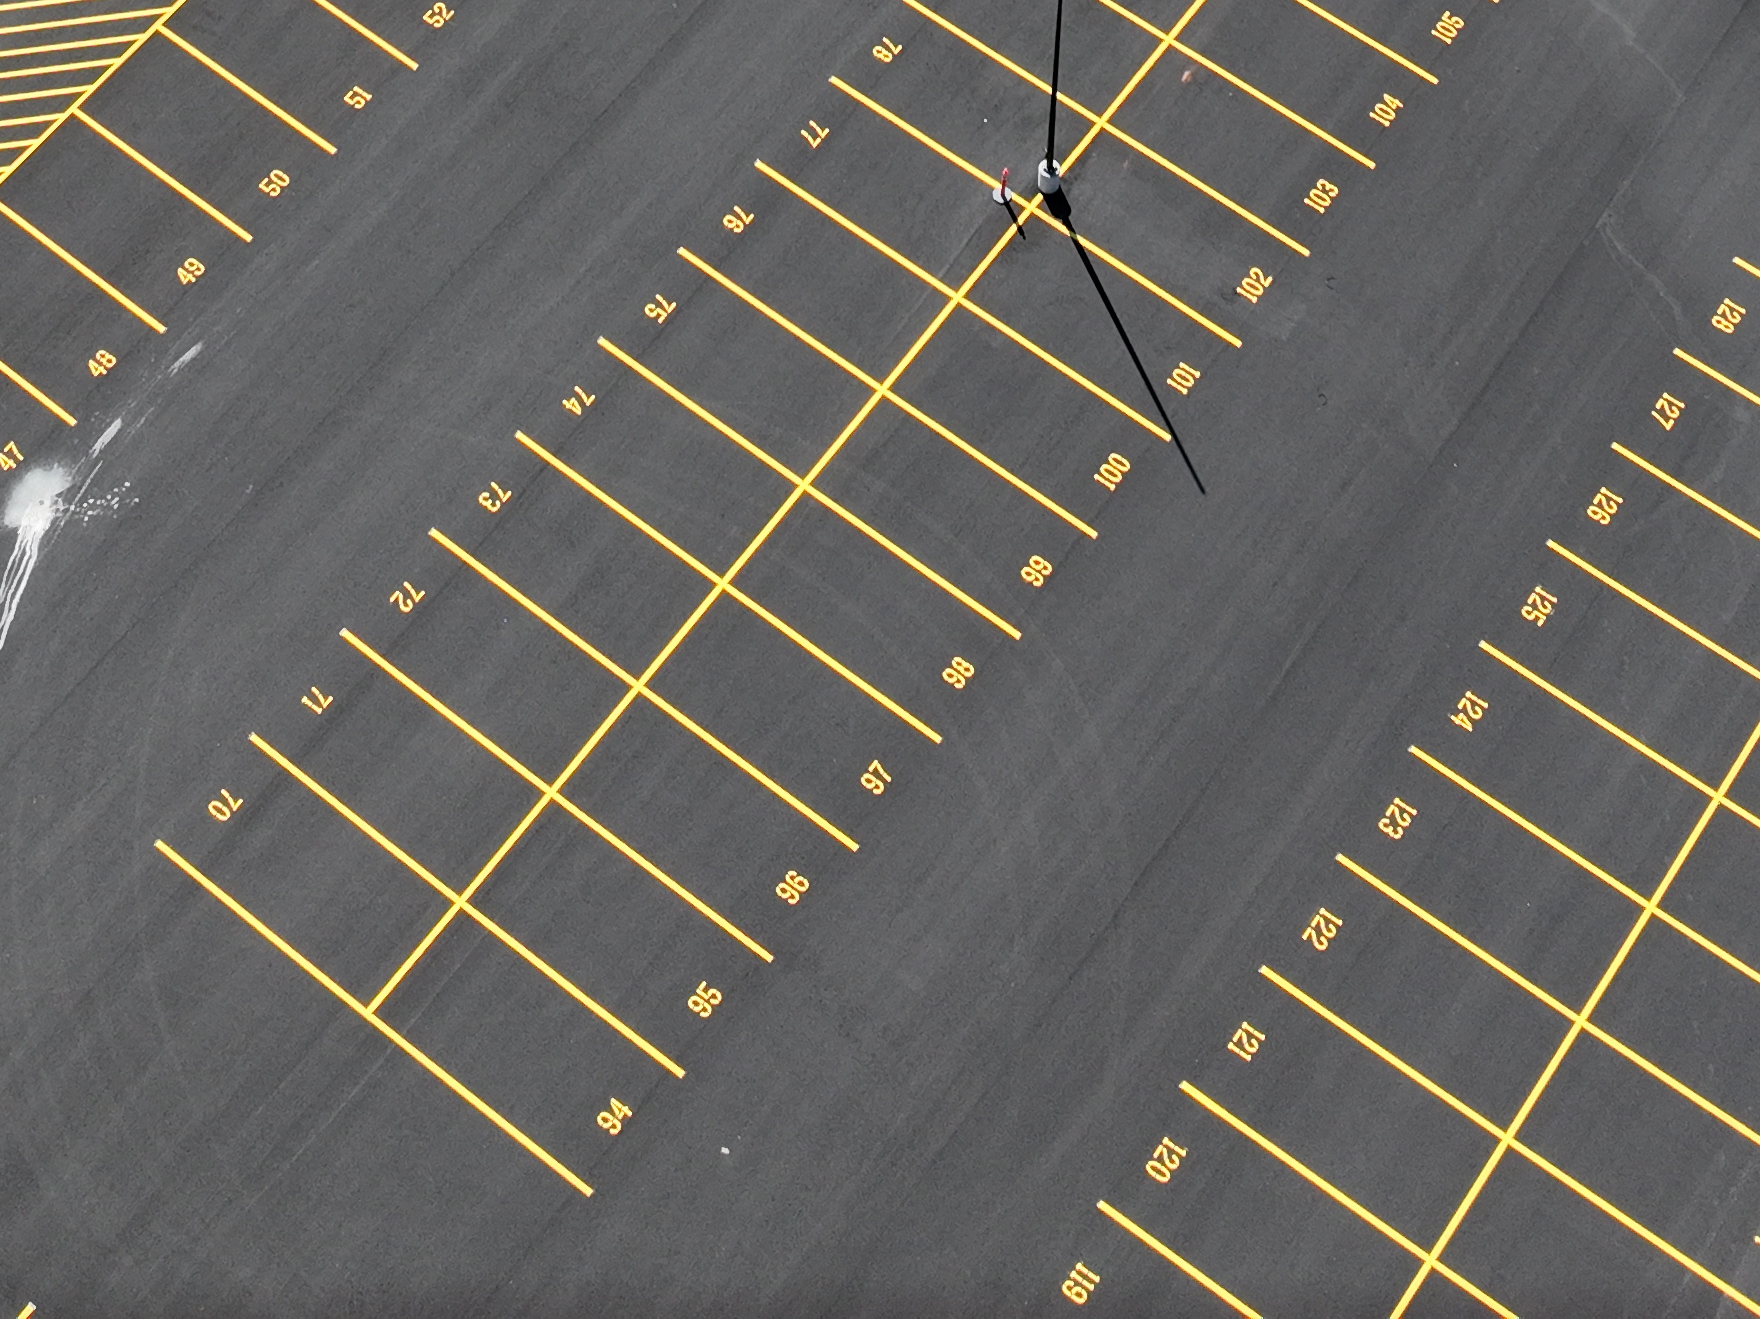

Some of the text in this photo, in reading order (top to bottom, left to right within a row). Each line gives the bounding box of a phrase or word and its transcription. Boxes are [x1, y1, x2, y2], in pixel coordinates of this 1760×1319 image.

[423, 2, 454, 28] 52
[872, 37, 902, 63] 78
[1369, 94, 1403, 127] 104
[258, 170, 290, 197] 50
[723, 206, 754, 233] 76
[1236, 267, 1273, 304] 102
[88, 350, 116, 377] 48
[562, 386, 595, 415] 74
[1651, 392, 1685, 431] 127
[1094, 453, 1130, 491] 100
[390, 582, 425, 613] 72
[1521, 586, 1557, 627] 125
[942, 657, 974, 689] 98
[208, 789, 243, 821] 70
[1378, 797, 1417, 839] 123
[776, 871, 809, 905] 96
[1227, 1021, 1265, 1062] 121
[597, 1098, 632, 1135] 94
[1146, 1137, 1188, 1183] 120
[1062, 1262, 1100, 1305] 119
